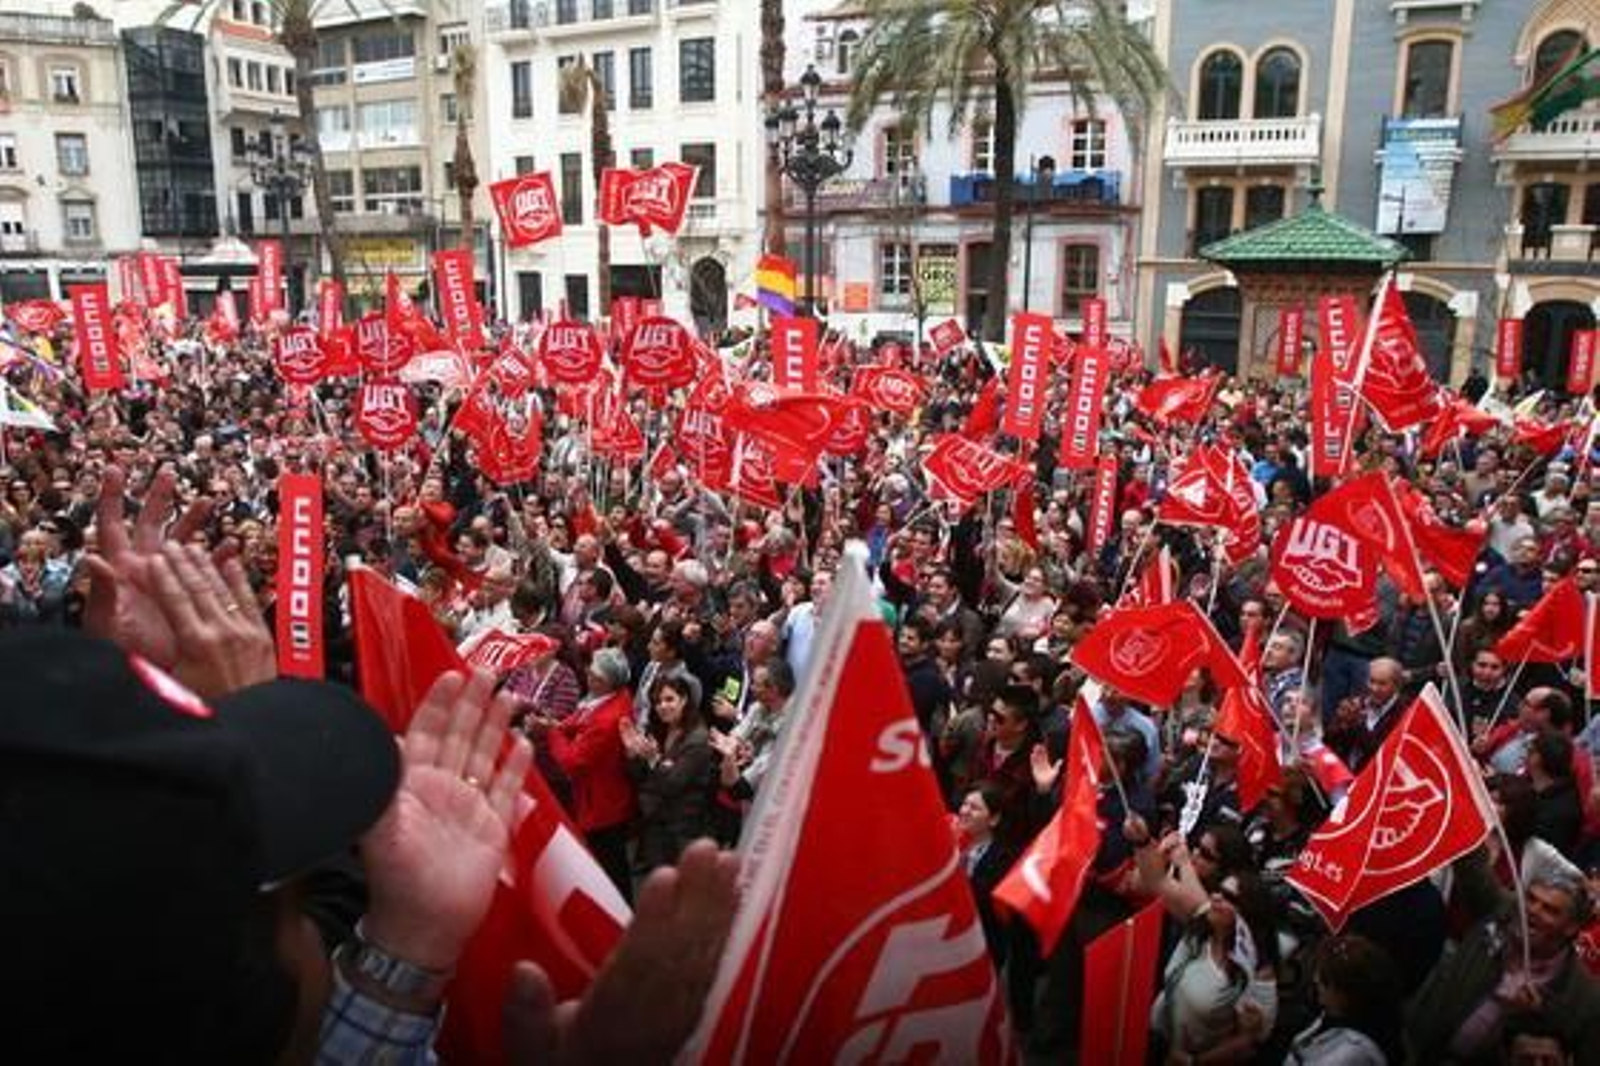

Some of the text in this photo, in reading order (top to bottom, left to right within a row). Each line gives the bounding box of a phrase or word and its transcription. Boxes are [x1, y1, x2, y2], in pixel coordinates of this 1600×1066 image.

[81, 293, 106, 358] CCOO
[281, 333, 319, 356] UGT
[548, 327, 588, 351] UGT
[634, 324, 680, 349] UGT
[1018, 324, 1042, 398] CCOO
[363, 384, 406, 413] UGT
[1075, 358, 1098, 431] CCOO
[683, 408, 723, 440] UGT
[290, 497, 311, 616] CCOO
[1286, 518, 1358, 570] UGT
